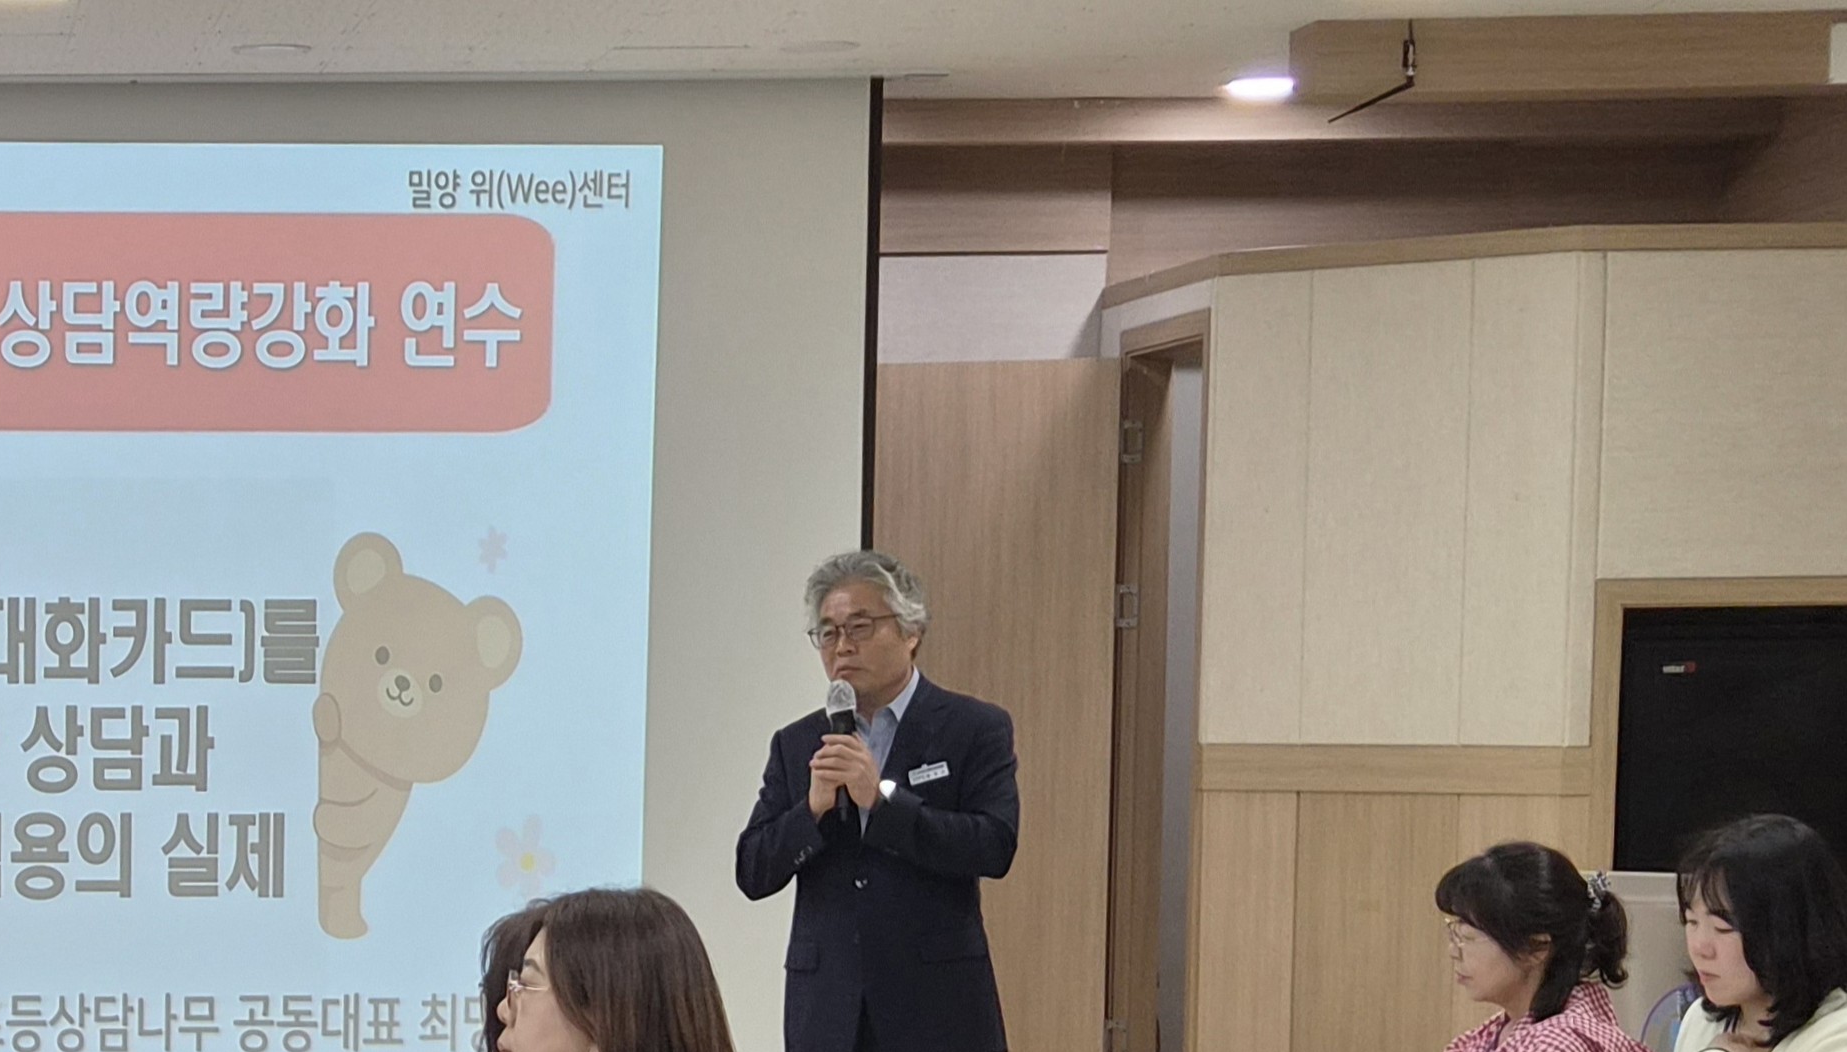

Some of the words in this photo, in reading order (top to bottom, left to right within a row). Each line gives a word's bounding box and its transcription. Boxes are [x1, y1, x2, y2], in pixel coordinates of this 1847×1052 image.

[408, 169, 462, 210] 밀양
[469, 169, 632, 211] 위(Wee)센터
[399, 281, 524, 370] 연수
[20, 705, 217, 796] 상담과
[161, 812, 288, 901] 실제
